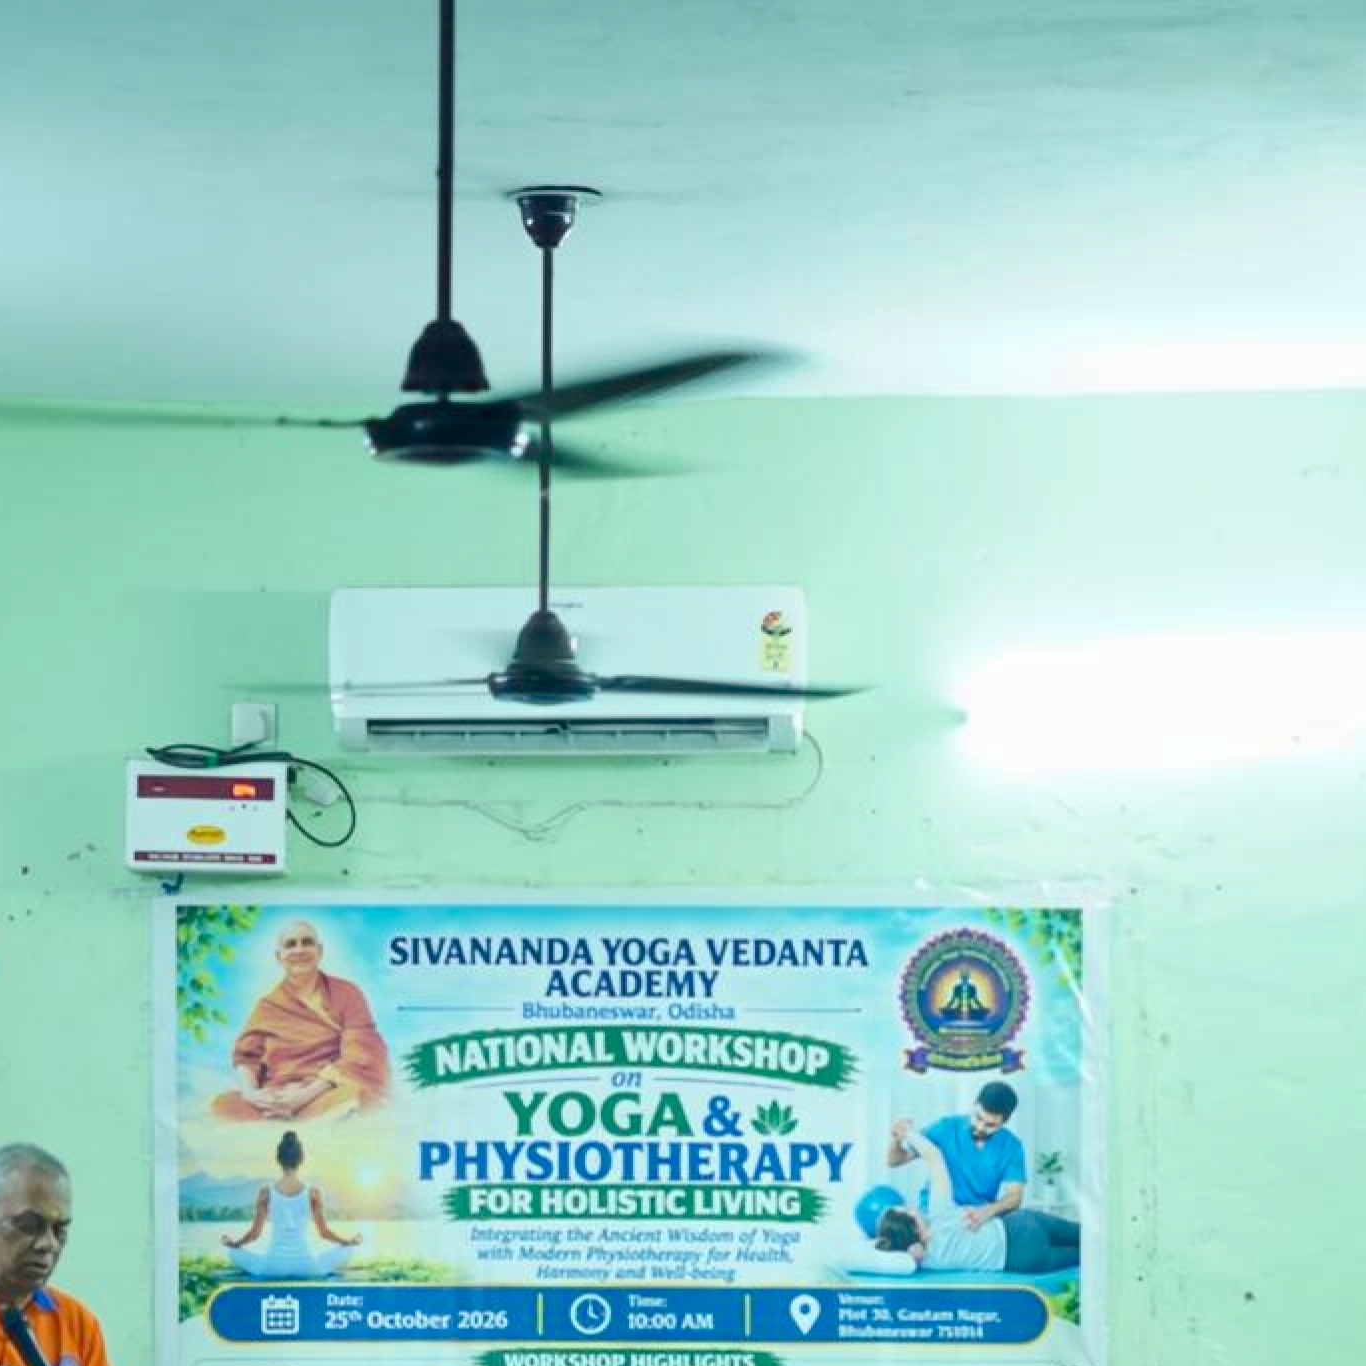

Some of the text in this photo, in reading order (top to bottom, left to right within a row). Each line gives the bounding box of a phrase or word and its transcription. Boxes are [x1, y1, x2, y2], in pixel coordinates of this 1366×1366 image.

[389, 936, 869, 968] SIVANANDA YOGA VEDANTA
[545, 969, 719, 998] ACADEMY
[522, 1002, 736, 1020] Bhubaneswar, Odisha
[435, 1031, 830, 1077] NATIONAL WORKSHOP
[611, 1071, 642, 1087] on
[502, 1091, 744, 1138] YOGA &
[418, 1141, 854, 1184] PHYSIOTHERAPY
[470, 1189, 802, 1217] FOR HOLISTIC LIVING
[470, 1227, 802, 1246] Integrating the Ancient Wisdom of Yoga
[477, 1246, 514, 1260] with
[517, 1246, 585, 1261] Modern
[586, 1247, 703, 1264] Physiotherapy
[706, 1247, 732, 1264] for
[536, 1265, 736, 1283] Harmony and Well-being
[324, 1311, 509, 1330] 25th October 2026
[627, 1313, 714, 1330] 10:00 AM
